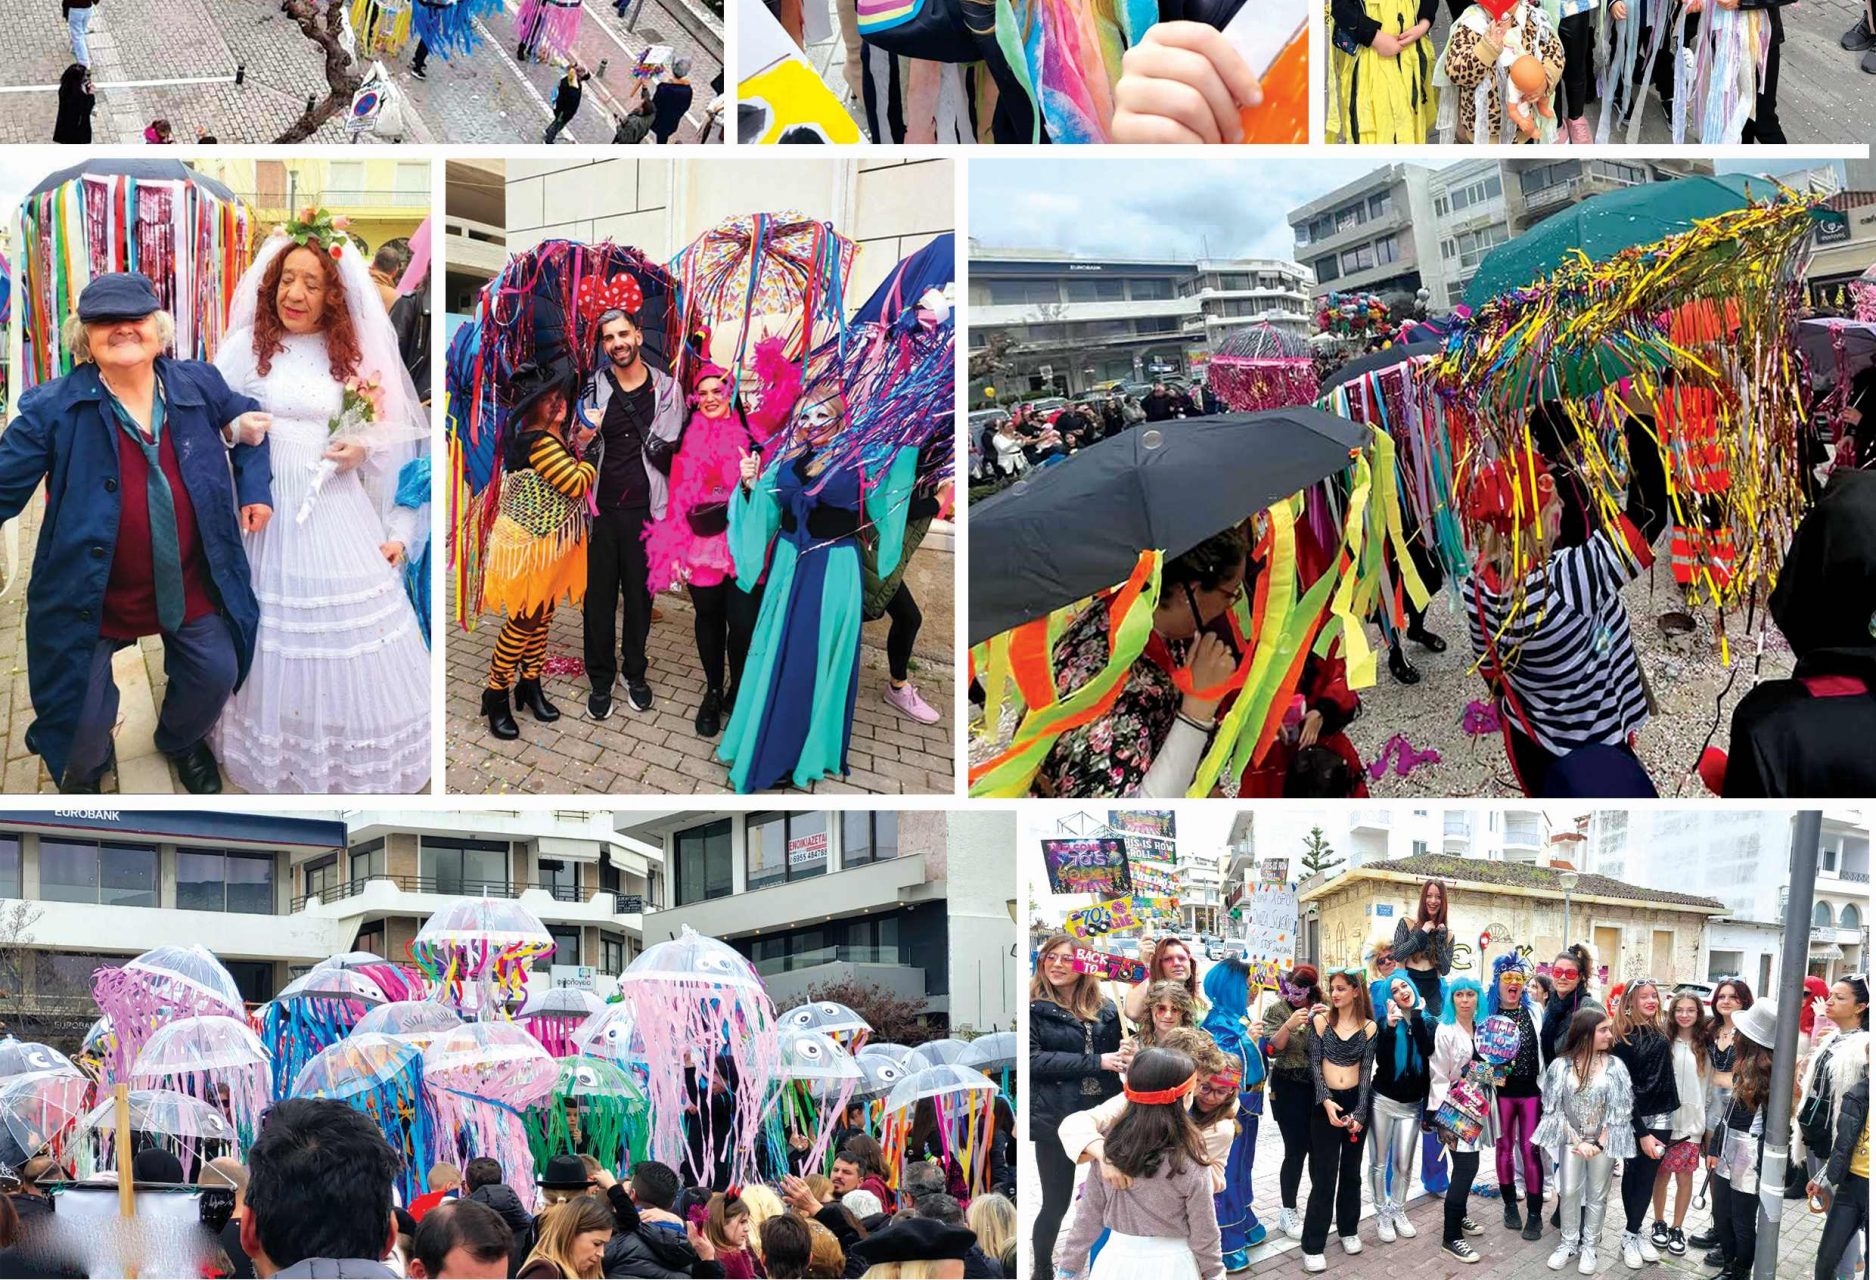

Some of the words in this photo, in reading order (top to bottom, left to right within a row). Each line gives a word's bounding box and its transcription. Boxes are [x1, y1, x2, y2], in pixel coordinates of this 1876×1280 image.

[54, 809, 120, 821] EUROBANK
[1154, 841, 1174, 852] HOW
[1081, 905, 1111, 925] 70's
[1076, 948, 1109, 965] BACK
[1083, 963, 1099, 974] TO
[1487, 1018, 1516, 1037] TIME
